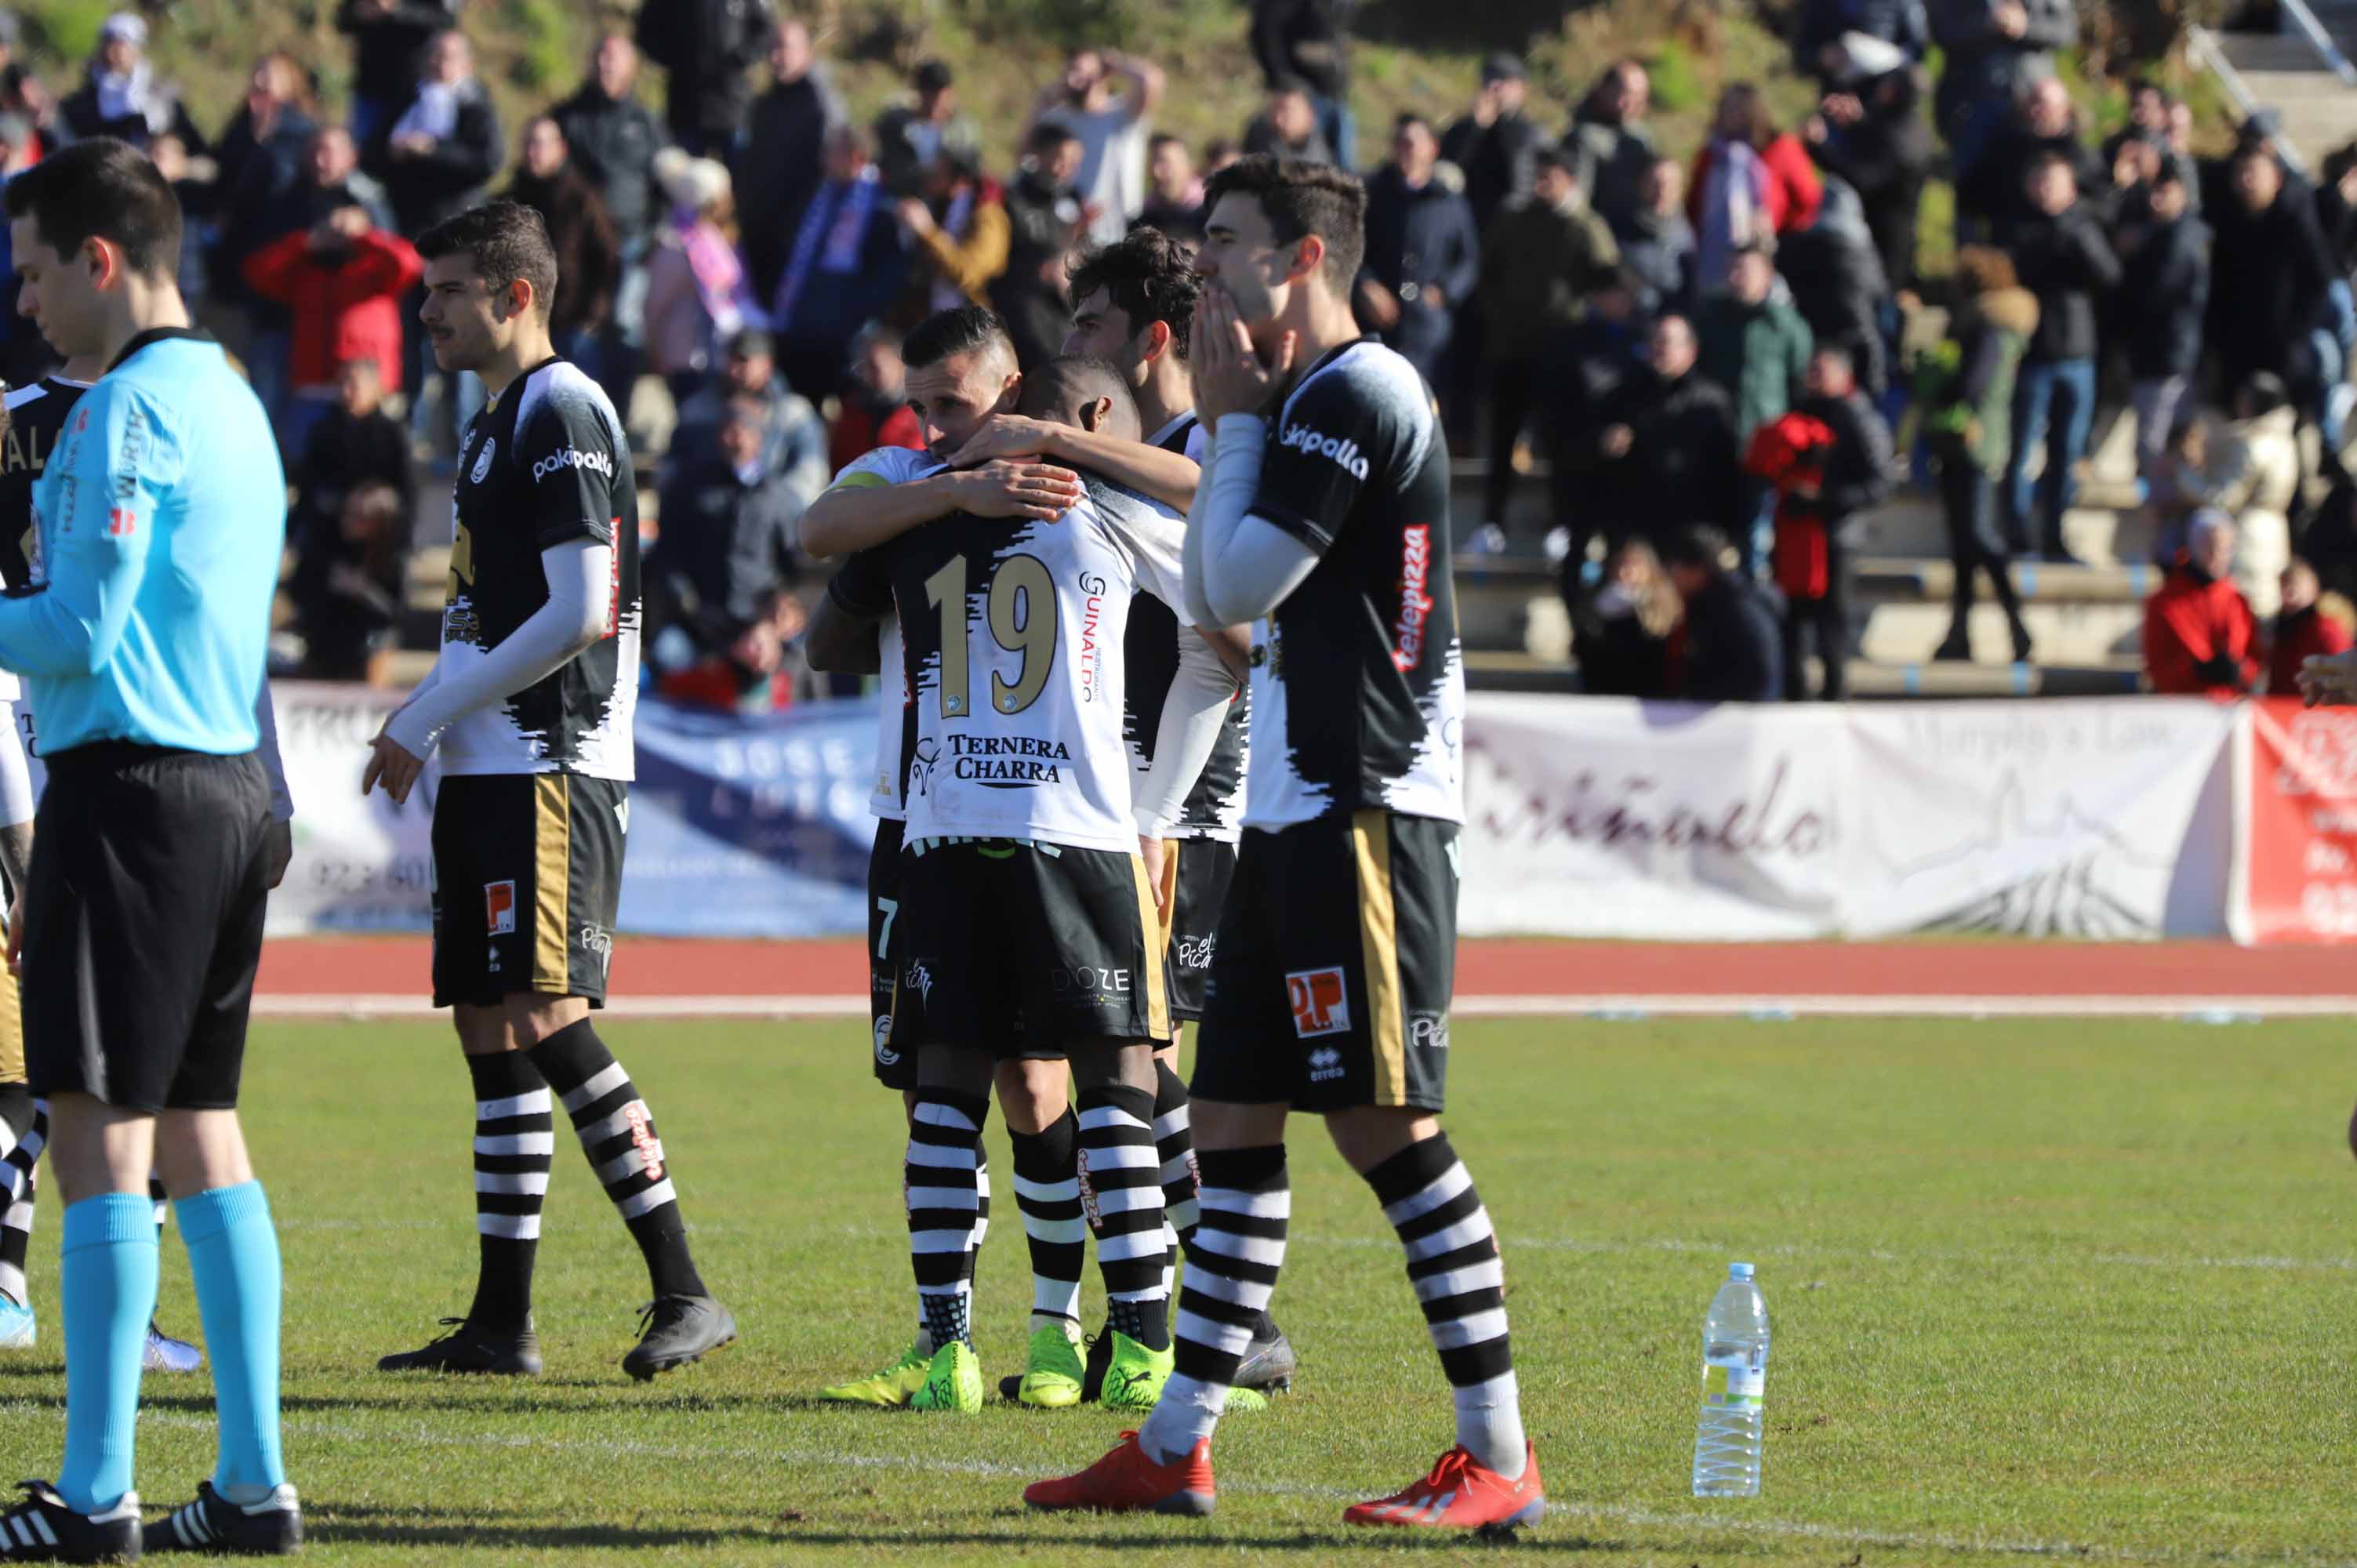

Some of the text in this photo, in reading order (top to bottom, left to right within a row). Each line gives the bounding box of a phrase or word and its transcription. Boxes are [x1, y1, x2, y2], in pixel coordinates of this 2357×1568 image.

[924, 553, 1057, 720] 19
[1079, 571, 1106, 703] GUINALDO
[947, 734, 1071, 760] TERNERA
[954, 757, 1061, 784] CHARRA
[877, 896, 899, 960] 7
